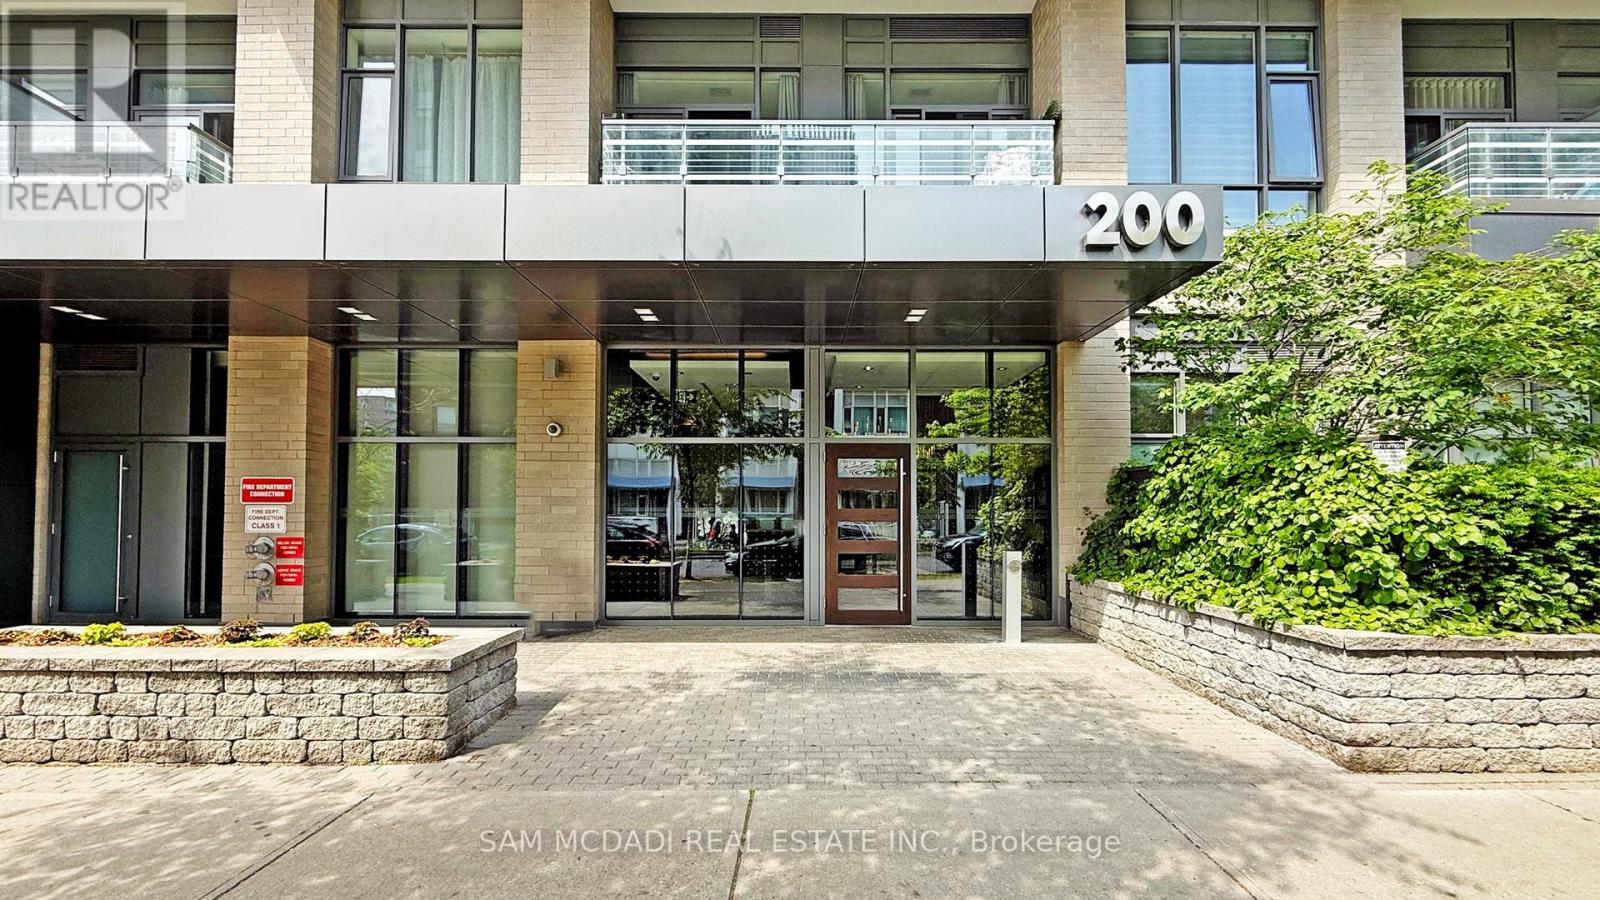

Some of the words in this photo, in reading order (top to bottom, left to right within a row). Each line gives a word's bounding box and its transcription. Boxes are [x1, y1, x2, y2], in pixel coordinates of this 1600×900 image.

[1083, 190, 1206, 249] 200
[242, 483, 255, 491] FIRE
[256, 483, 293, 491] DEPARTMENT
[251, 522, 275, 530] CLASS
